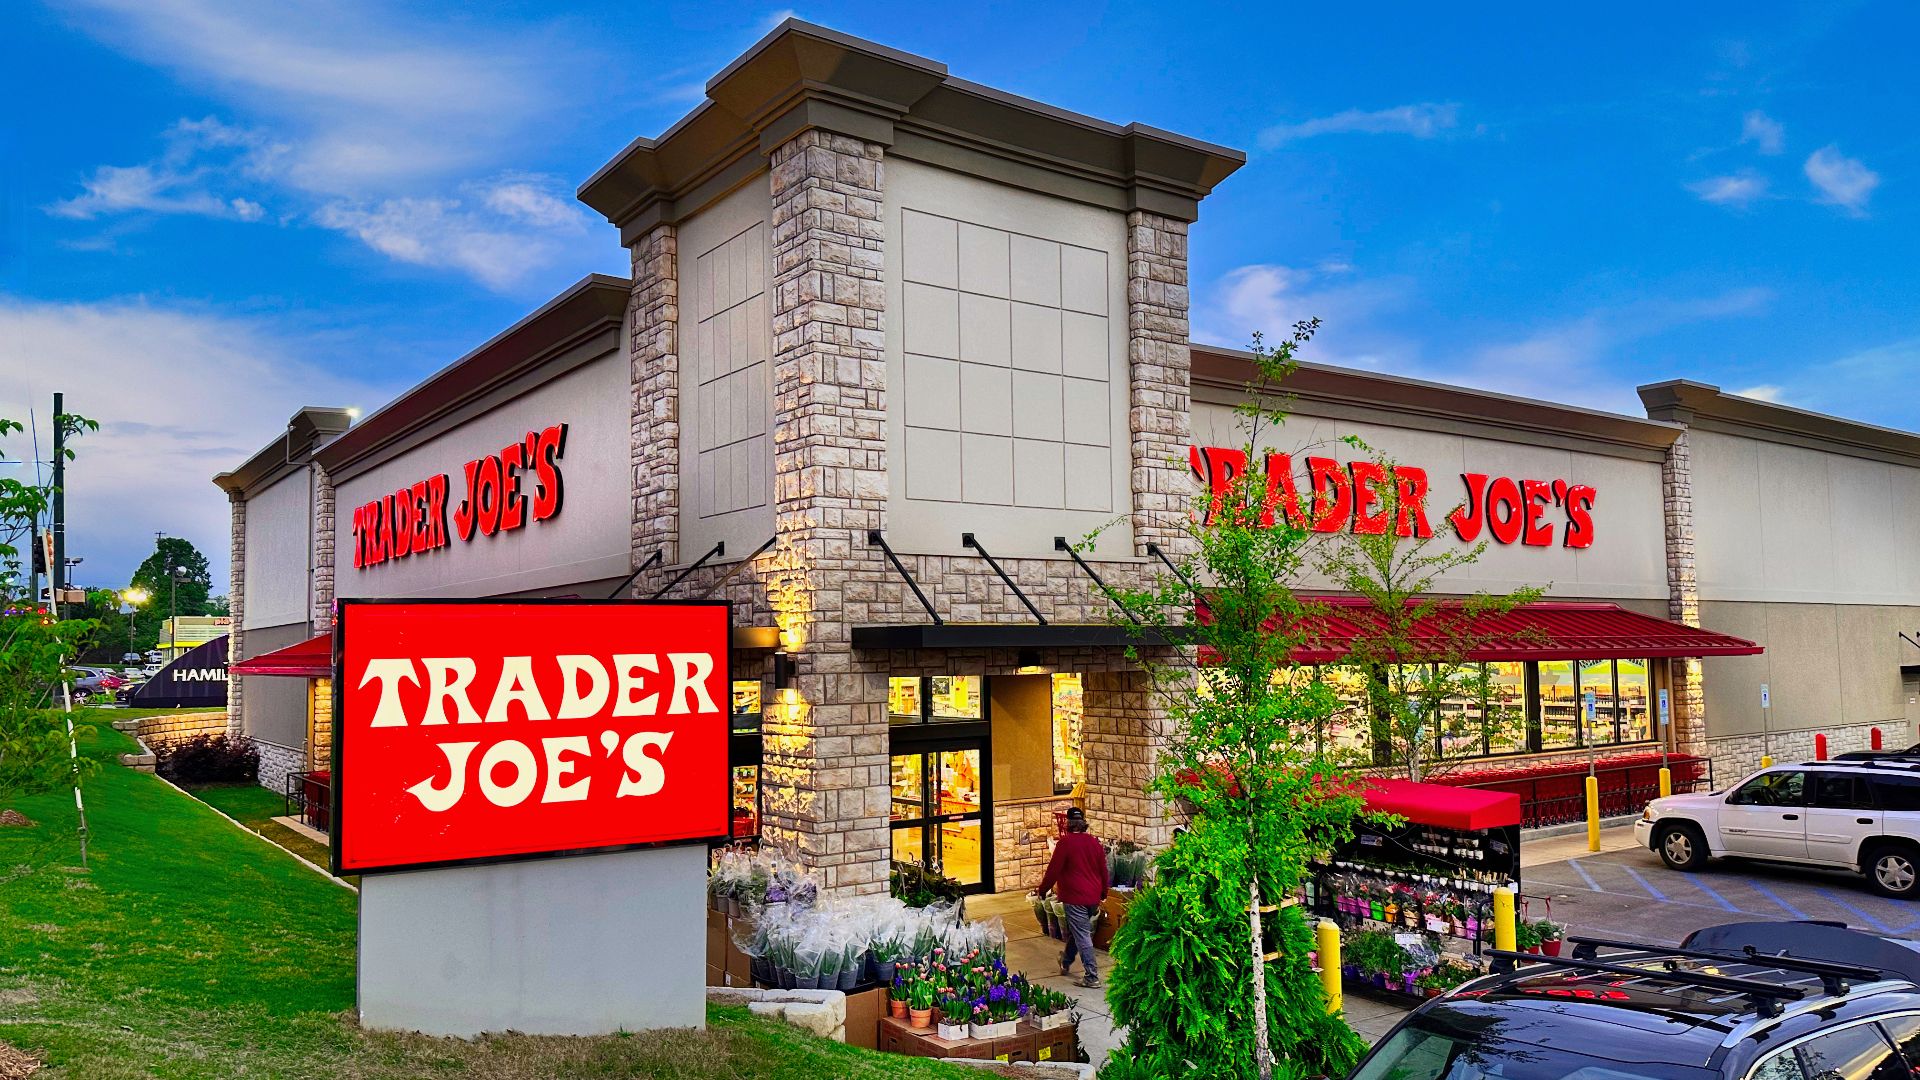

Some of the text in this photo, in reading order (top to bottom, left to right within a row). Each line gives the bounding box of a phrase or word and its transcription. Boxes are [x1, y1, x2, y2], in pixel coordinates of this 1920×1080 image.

[352, 423, 568, 569] TRADER JOE'S
[1446, 472, 1597, 548] JOE'S
[358, 652, 719, 728] TRADER
[405, 730, 675, 812] JOE'S
